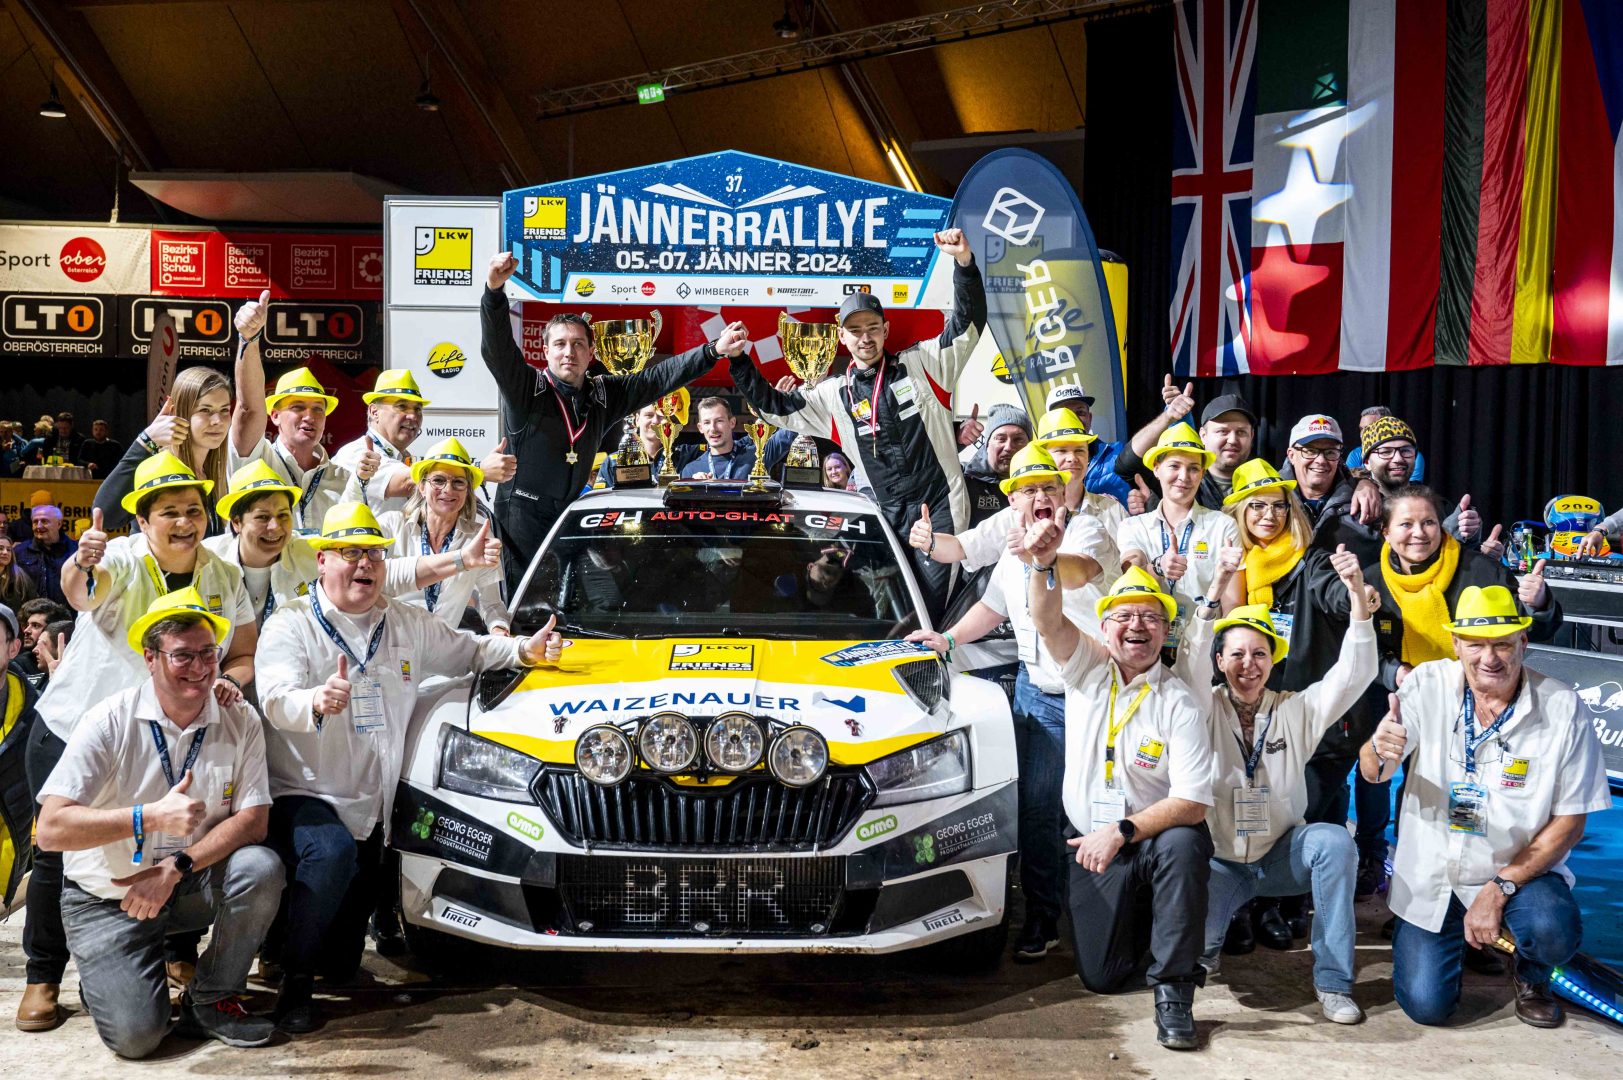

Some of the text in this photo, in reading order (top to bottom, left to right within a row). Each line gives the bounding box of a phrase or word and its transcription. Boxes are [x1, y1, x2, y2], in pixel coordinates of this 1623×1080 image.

[725, 175, 747, 193] 37.
[573, 183, 889, 249] JÄNNERRALLYE
[438, 231, 469, 240] LKW
[524, 228, 566, 236] FRIENDS
[162, 244, 199, 254] Bezirks
[228, 246, 264, 256] Bezirks
[294, 247, 329, 257] Bezirks
[0, 250, 50, 271] Sport
[60, 249, 107, 265] ober
[162, 254, 190, 263] Rund
[228, 256, 256, 265] Rund
[294, 257, 321, 266] Rund
[615, 246, 853, 273] 05.-07. JÄNNER 2024
[162, 263, 196, 273] Schau
[228, 265, 262, 274] Schau
[294, 266, 327, 275] Schau
[415, 269, 471, 279] FRIENDS
[611, 285, 637, 294] Sport
[694, 287, 750, 296] WIMBERGER
[15, 304, 93, 331] LT1
[276, 311, 353, 337] LT1
[3, 340, 103, 353] OBERÖSTERREICH
[426, 349, 468, 367] Life
[426, 428, 486, 438] WIMBERGER
[651, 511, 795, 523] AUTO-GH.AT
[548, 692, 801, 716] WAIZENAUER
[437, 816, 493, 846] GEORG EGGER
[936, 812, 995, 840] GEORG EGGER
[433, 835, 489, 861] PRODUKTMANAGEMENT
[939, 831, 999, 856] PRODUKTMANAGEMENT
[625, 864, 789, 923] BRR
[441, 906, 482, 928] PIRELLI
[921, 908, 964, 931] PIRELLI
